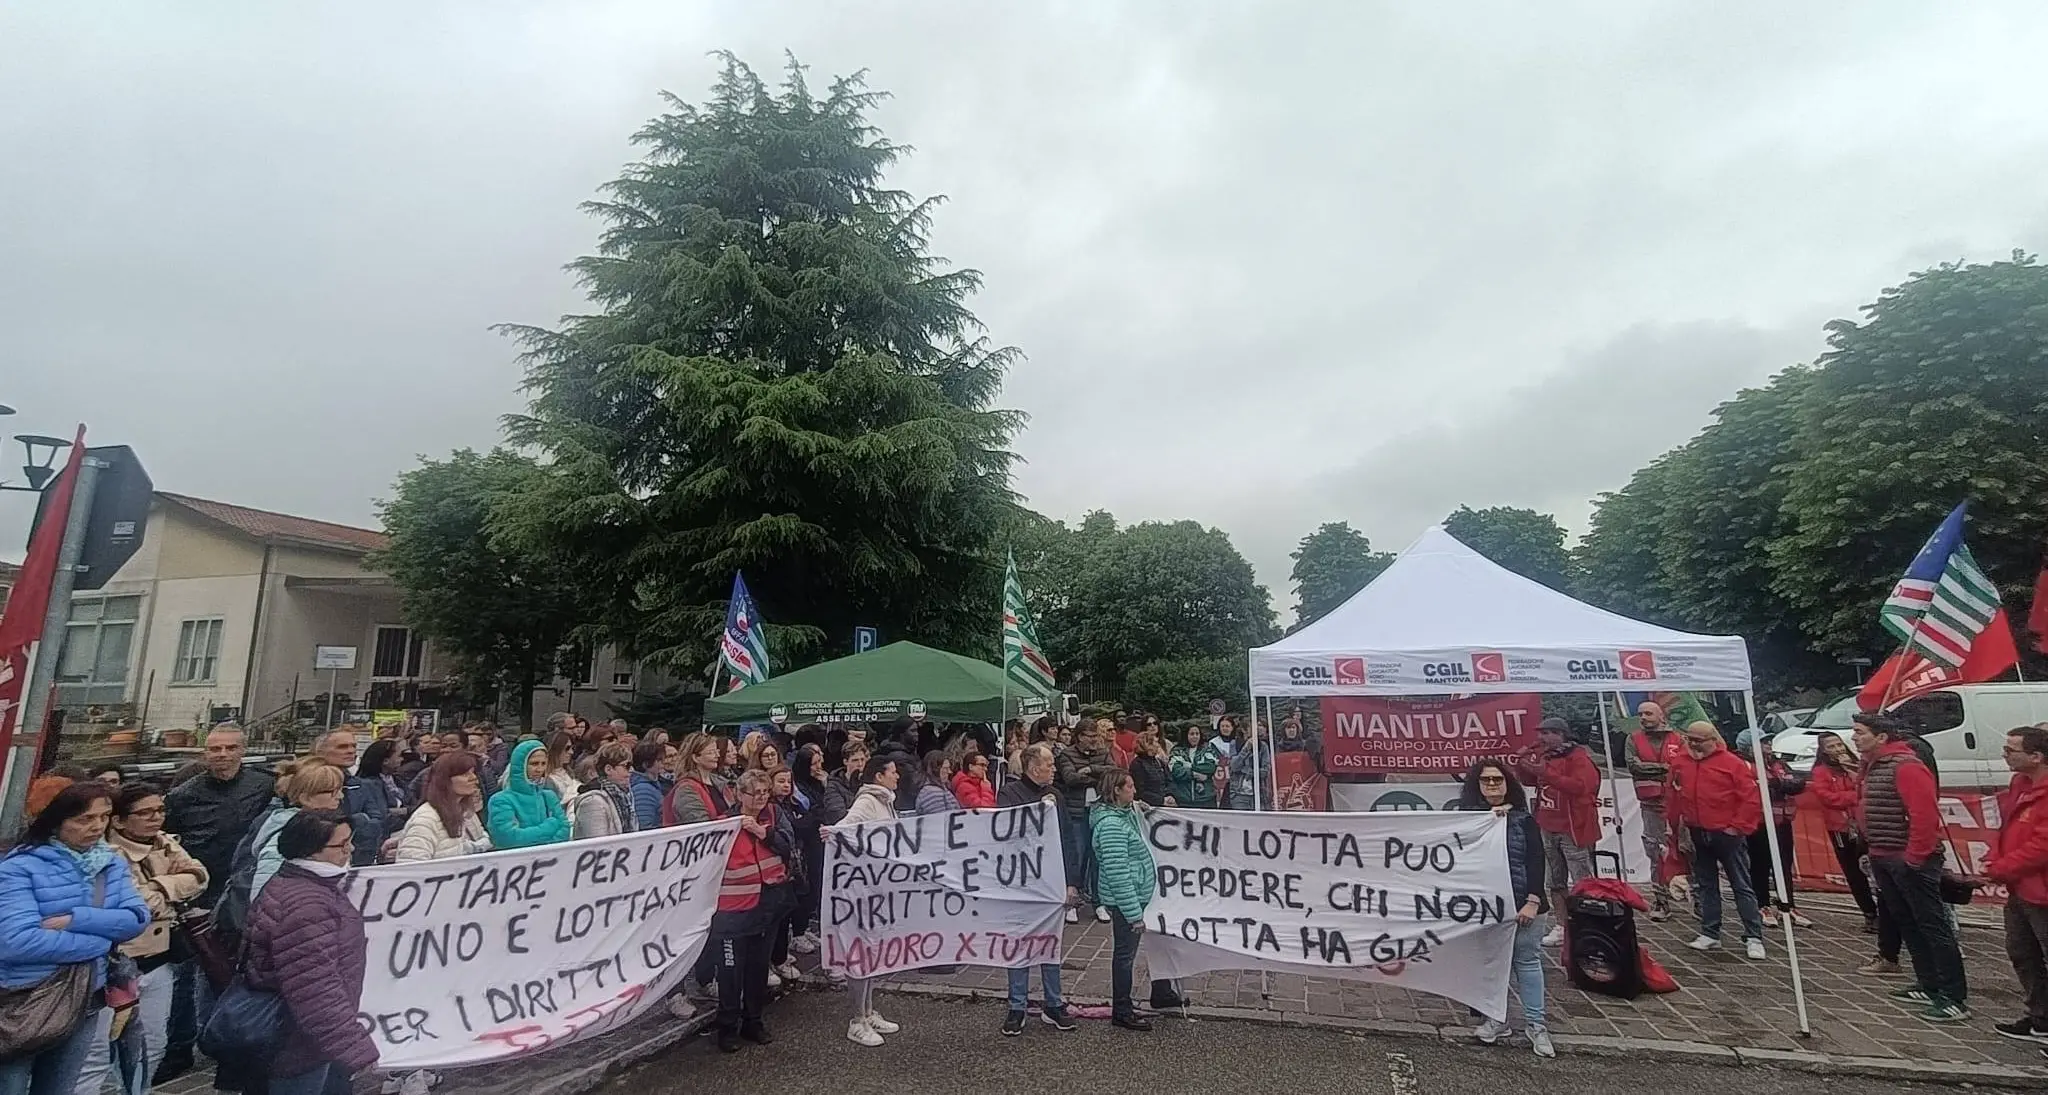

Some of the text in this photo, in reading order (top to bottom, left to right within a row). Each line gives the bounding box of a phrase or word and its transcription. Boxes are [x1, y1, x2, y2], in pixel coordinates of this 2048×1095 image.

[860, 630, 871, 653] P
[1288, 666, 1332, 679] CGIL
[1423, 663, 1469, 677] CGIL
[1567, 660, 1617, 673] CGIL
[816, 713, 878, 723] ASSE DEL PO
[1335, 709, 1528, 739] MANTUA.IT
[1333, 754, 1460, 768] CASTELBELFORTE
[1361, 738, 1511, 751] GRUPPO ITALPIZZA
[834, 817, 924, 859] NON
[991, 803, 1046, 842] UN
[1149, 819, 1221, 856] CHI
[1243, 828, 1364, 868] LOTTA
[361, 829, 734, 922] LOTTARE PER I DIRITTI
[832, 860, 948, 890] FAVORE
[996, 846, 1043, 887] UN
[831, 888, 979, 929] DIRITTO:
[1158, 864, 1505, 925] PERDERE, CHI NON
[389, 922, 484, 979] UNO
[555, 876, 700, 944] LOTTARE
[1158, 913, 1280, 952] LOTTA
[1300, 926, 1352, 963] HA
[827, 932, 1059, 976] LAVORO X TUTTI
[355, 934, 677, 1045] PER I DIRITTI DI
